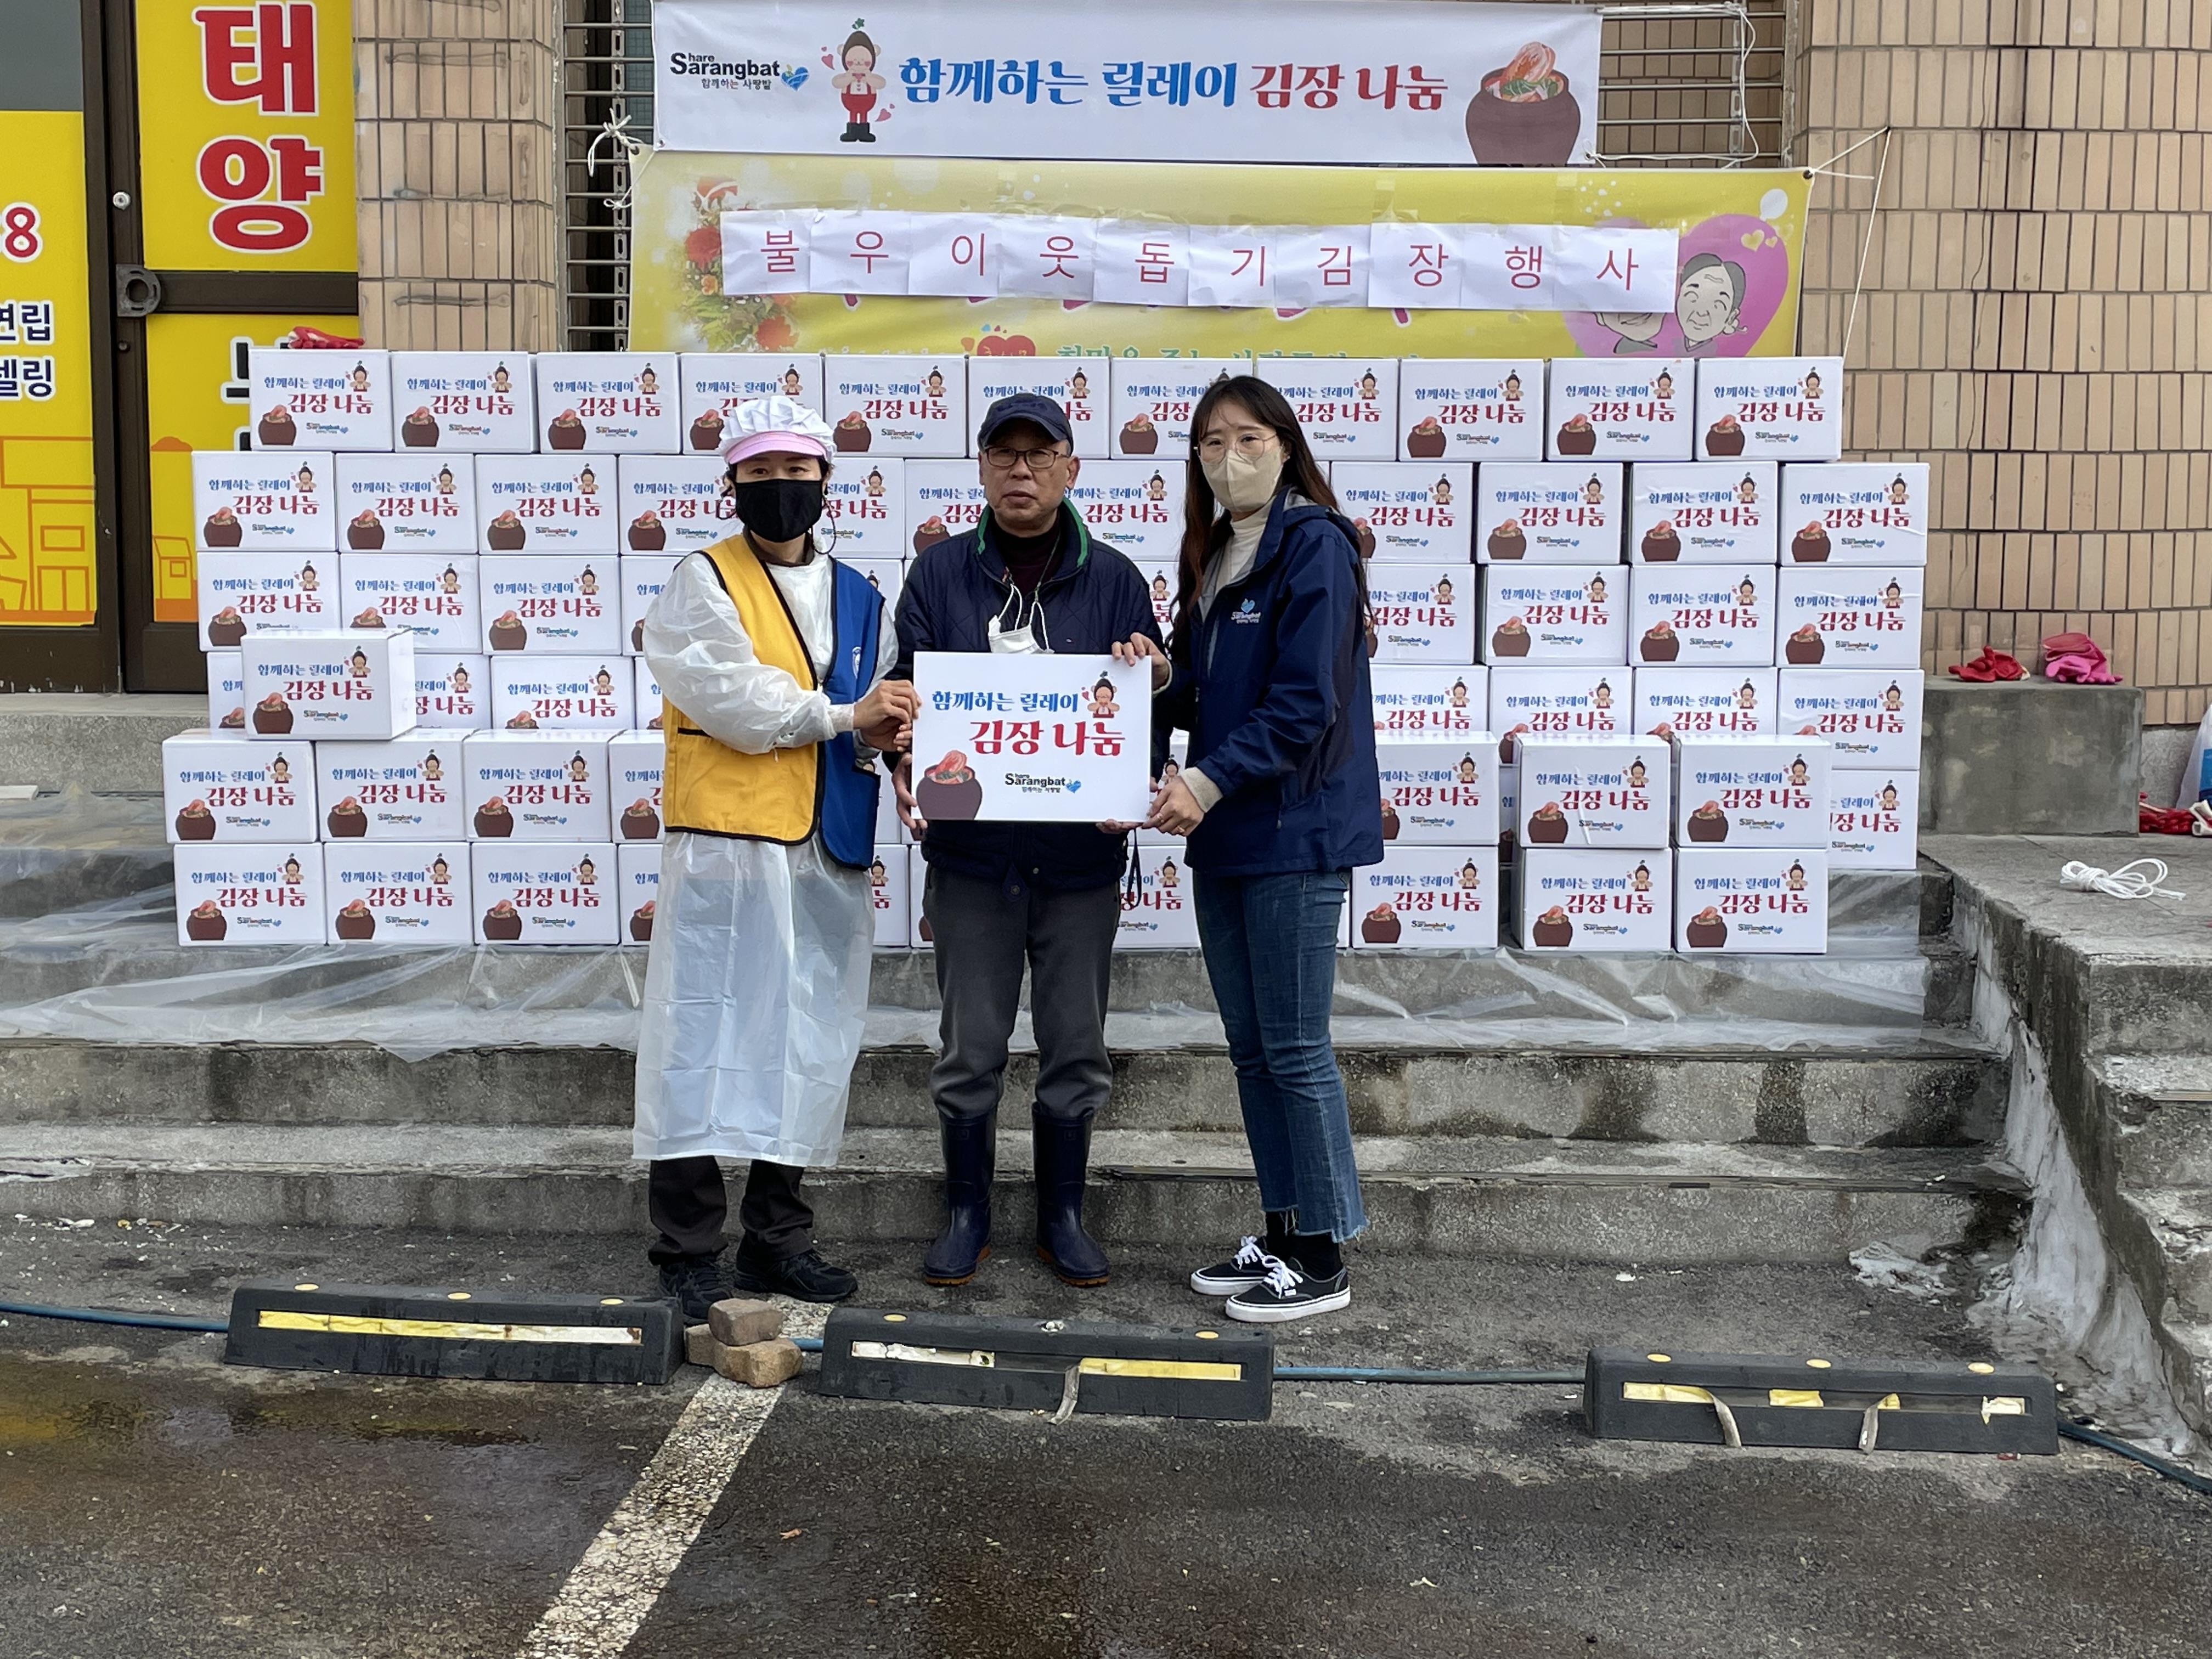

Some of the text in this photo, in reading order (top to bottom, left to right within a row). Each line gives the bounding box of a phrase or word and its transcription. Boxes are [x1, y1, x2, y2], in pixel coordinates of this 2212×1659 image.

[670, 52, 780, 80] Sarangbat
[899, 57, 1449, 111] 함께하는 릴레이 김장 나눔
[194, 2, 324, 252] 태양
[287, 393, 374, 415] 김장 나눔
[430, 394, 515, 416] 김장 나눔
[576, 396, 663, 417] 김장 나눔
[862, 399, 950, 420] 김장 나눔
[1149, 401, 1192, 422] 김장
[1341, 402, 1383, 422] 나눔
[1438, 403, 1526, 425] 김장 나눔
[1588, 401, 1677, 422] 김장 나눔
[1736, 401, 1826, 422] 김장 나눔
[232, 494, 320, 515] 김장 나눔
[375, 496, 460, 517] 김장 나눔
[515, 496, 603, 518] 김장 나눔
[657, 498, 698, 519] 김장
[849, 499, 889, 518] 나눔
[1084, 503, 1170, 524] 김장 나눔
[1368, 505, 1456, 528] 김장 나눔
[1519, 506, 1607, 527] 김장 나눔
[1672, 506, 1762, 528] 김장 나눔
[1822, 507, 1912, 529] 김장 나눔
[236, 593, 324, 614] 김장 나눔
[379, 595, 464, 616] 김장 나눔
[517, 597, 603, 618] 김장 나눔
[1417, 607, 1458, 627] 나눔
[1522, 604, 1611, 625] 김장 나눔
[1671, 608, 1760, 629] 김장 나눔
[1816, 611, 1906, 632] 김장 나눔
[283, 680, 375, 701] 김장 나눔
[435, 695, 476, 715] 나눔
[531, 697, 618, 719] 김장 나눔
[932, 690, 1079, 713] 함께하는 릴레이
[1431, 709, 1472, 730] 나눔
[1528, 710, 1617, 731] 김장 나눔
[1672, 710, 1760, 732] 김장 나눔
[1816, 713, 1906, 733] 김장 나눔
[969, 720, 1126, 757] 김장 나눔
[205, 786, 296, 808] 김장 나눔
[357, 783, 448, 805] 김장 나눔
[504, 784, 593, 805] 김장 나눔
[1391, 786, 1482, 807] 김장 나눔
[1559, 789, 1651, 811] 김장 나눔
[1719, 788, 1813, 809] 김장 나눔
[1860, 812, 1902, 833] 나눔
[216, 887, 308, 908] 김장 나눔
[365, 887, 455, 907] 김장 나눔
[512, 887, 601, 908] 김장 나눔
[1143, 890, 1184, 911] 나눔
[1392, 890, 1483, 912] 김장 나눔
[1565, 893, 1656, 915] 김장 나눔
[1718, 893, 1810, 915] 김장 나눔
